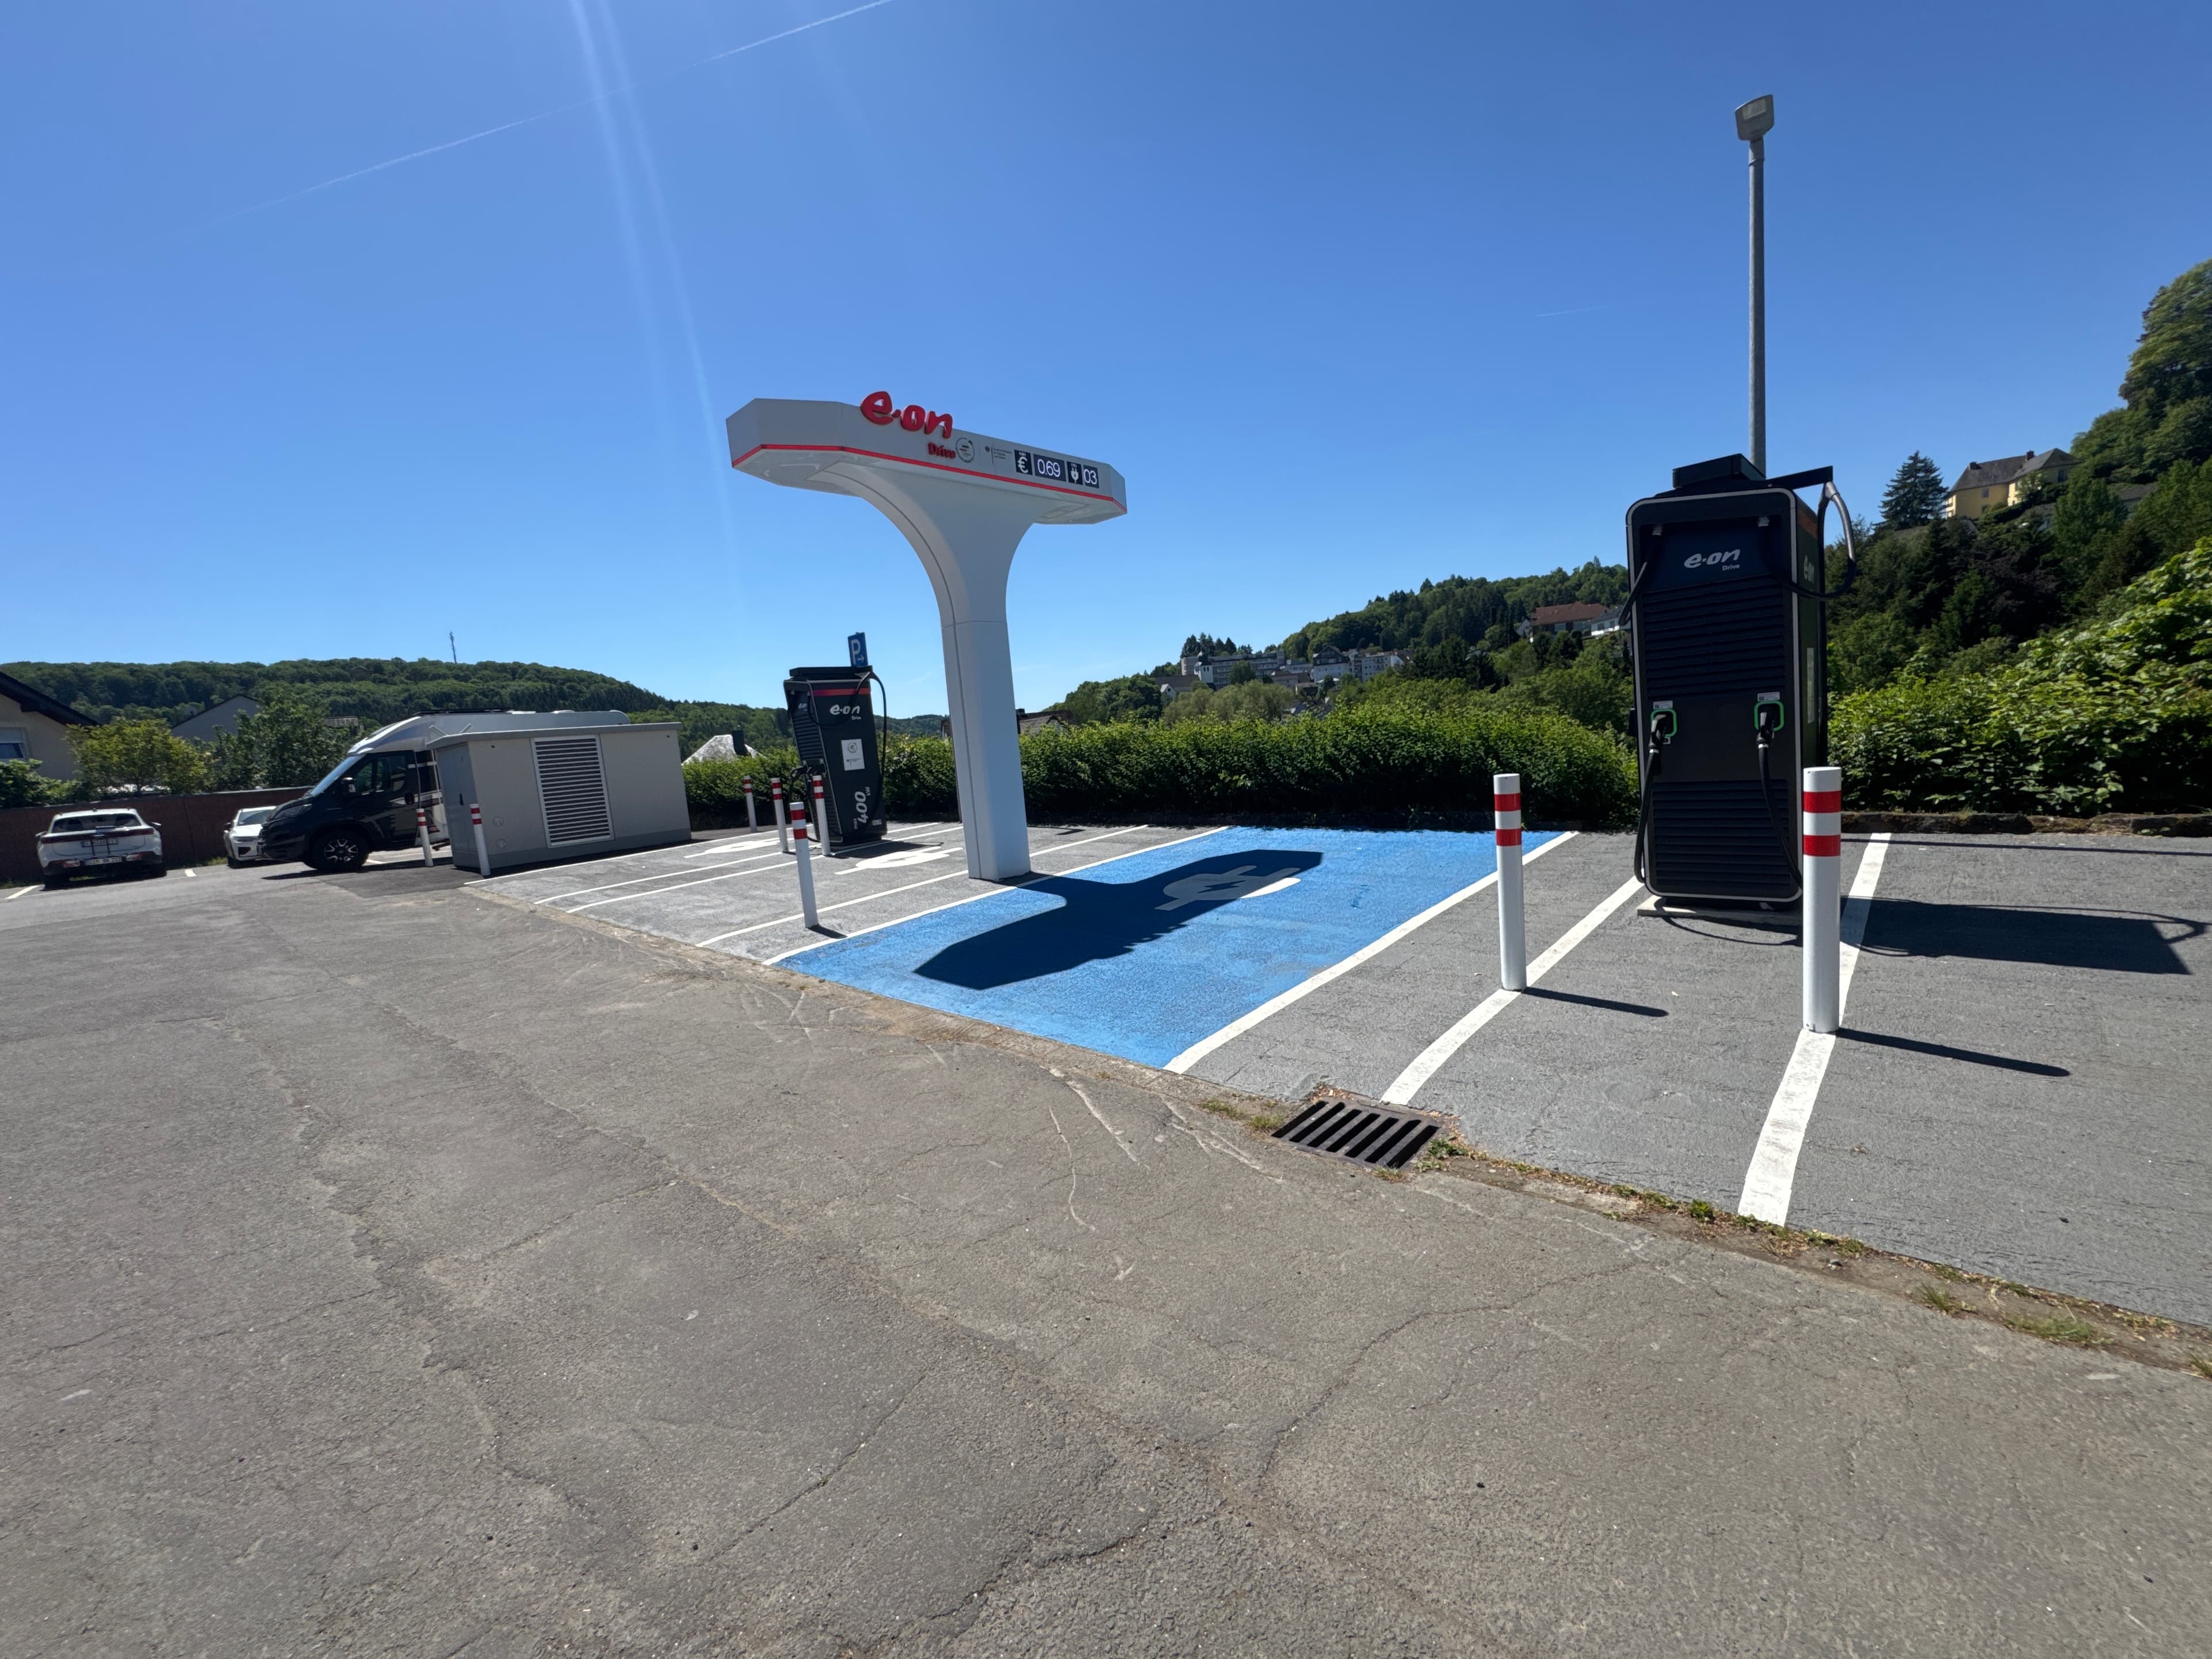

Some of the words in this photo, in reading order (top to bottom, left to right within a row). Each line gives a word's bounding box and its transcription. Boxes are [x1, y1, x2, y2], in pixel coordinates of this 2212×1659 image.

[1084, 469, 1097, 484] 03
[851, 639, 861, 665] P
[854, 791, 869, 824] 400
